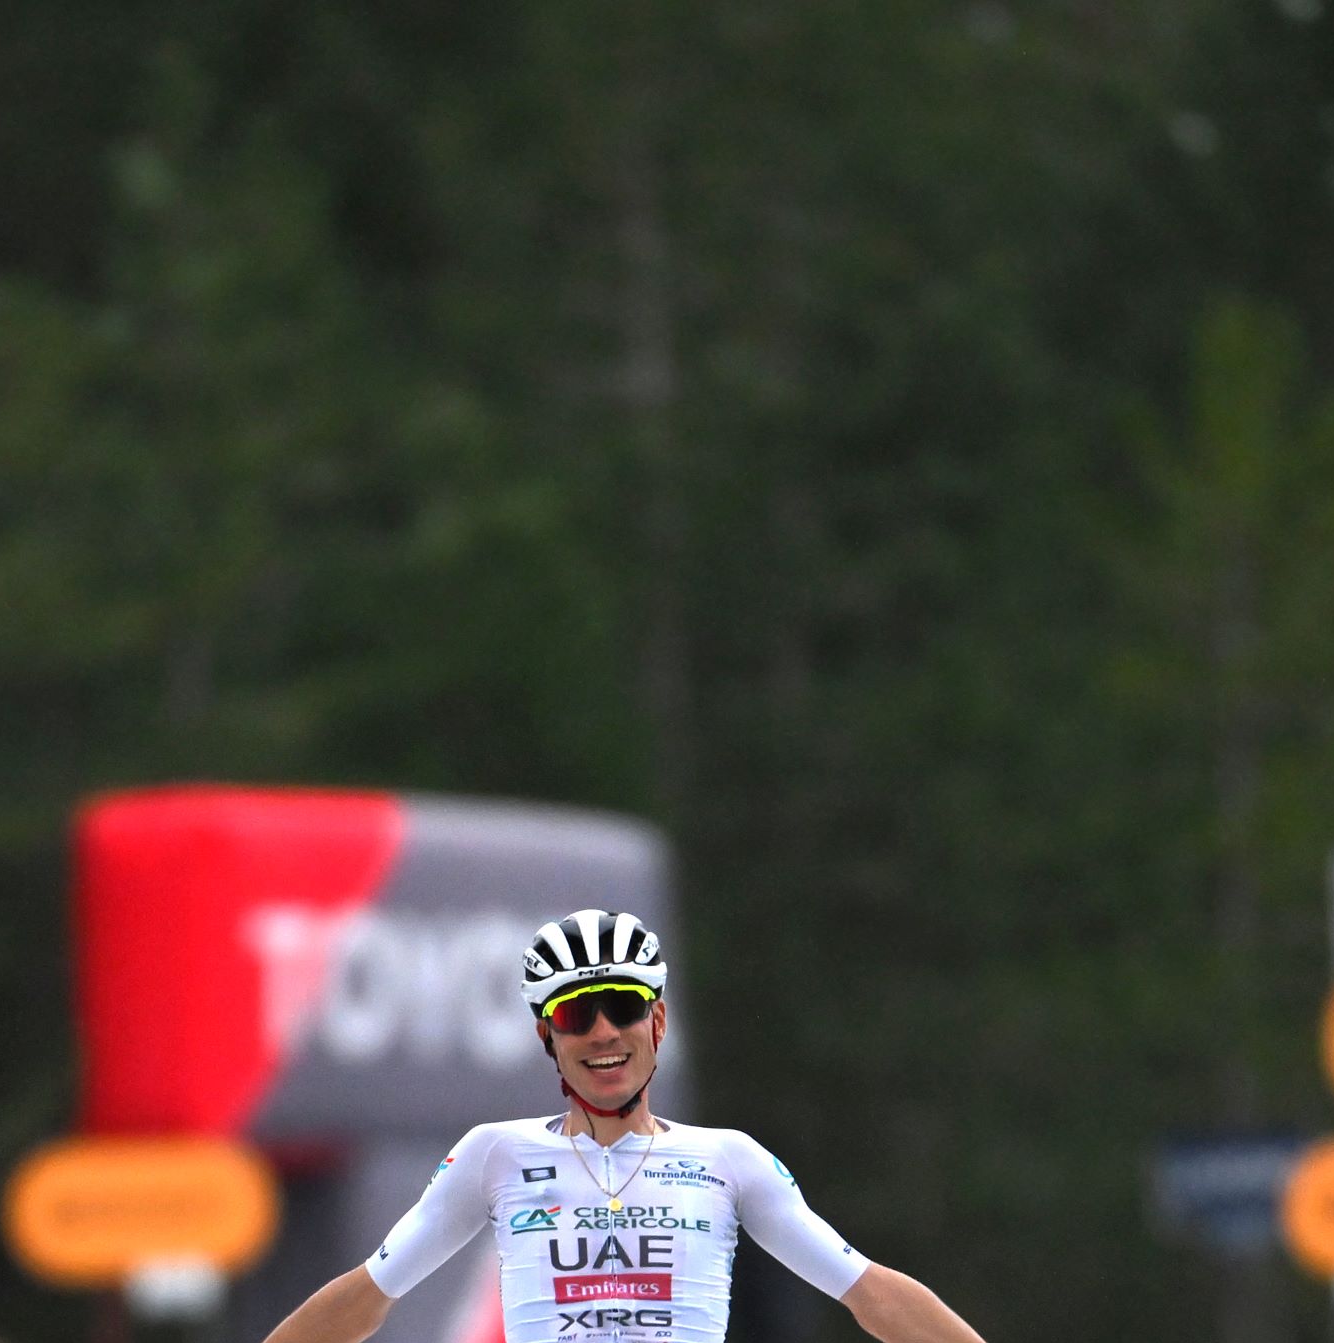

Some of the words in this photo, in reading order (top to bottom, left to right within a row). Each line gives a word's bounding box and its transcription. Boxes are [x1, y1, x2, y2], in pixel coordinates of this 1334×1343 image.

[578, 966, 611, 977] MET
[574, 1218, 711, 1233] AGRICOLE
[549, 1235, 674, 1272] UAE
[566, 1280, 660, 1298] Emirates
[558, 1308, 672, 1332] XRG
